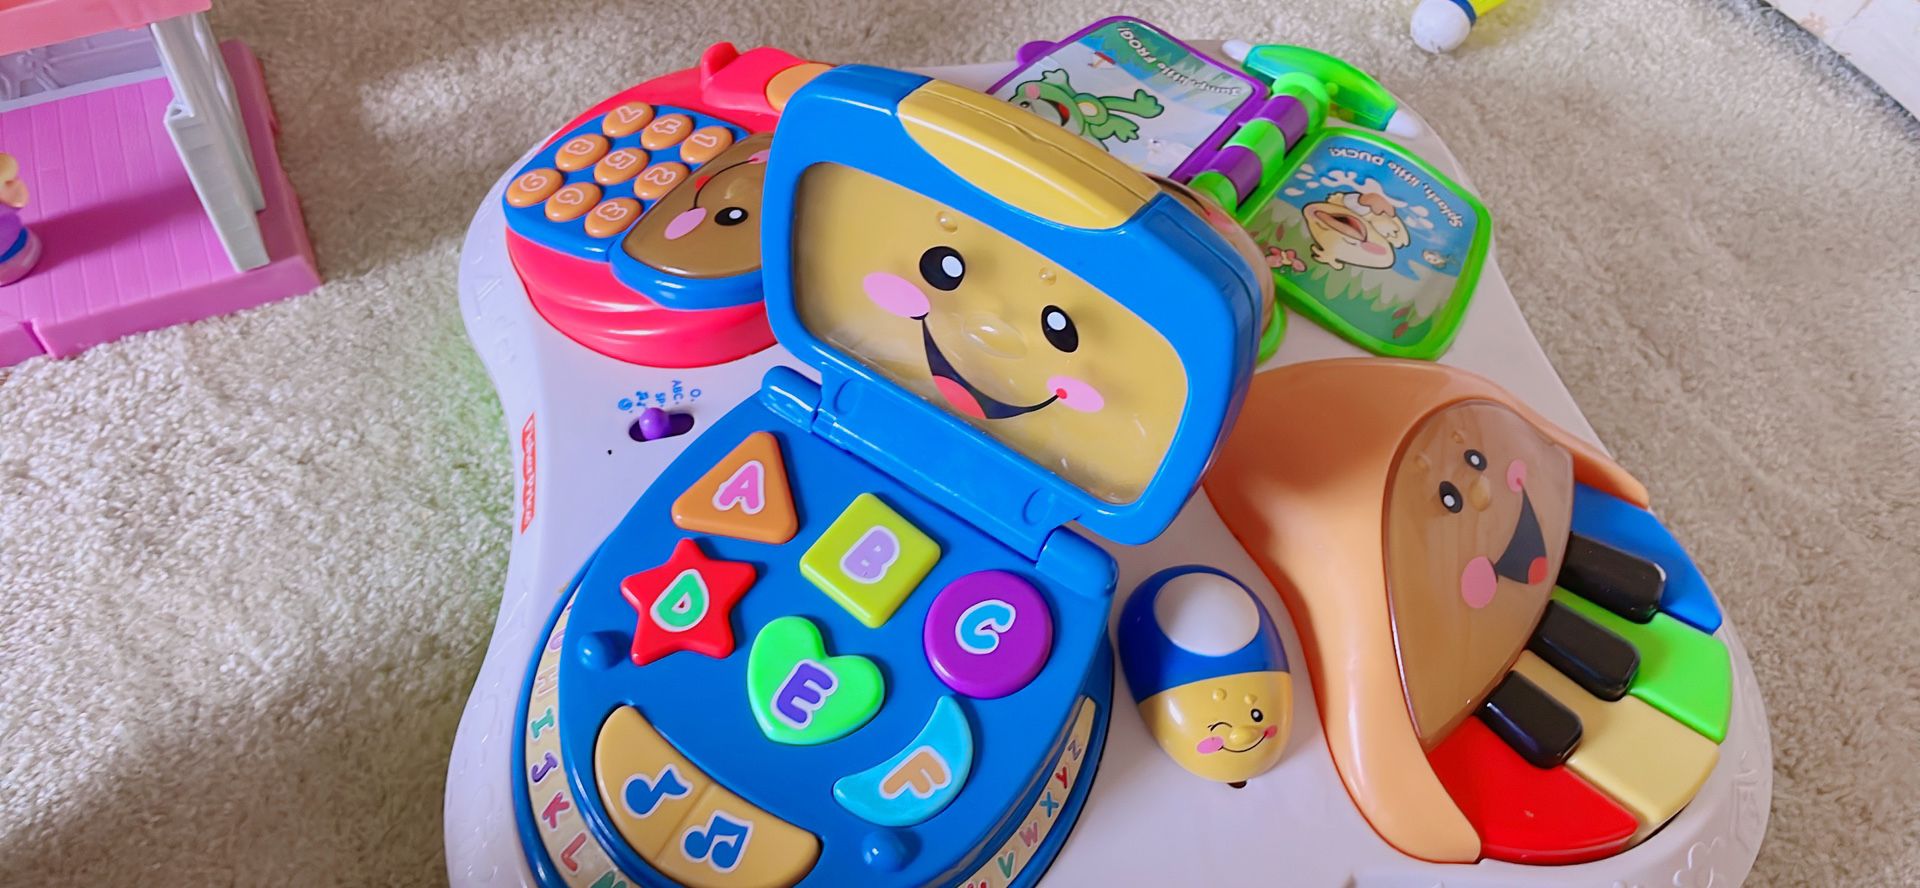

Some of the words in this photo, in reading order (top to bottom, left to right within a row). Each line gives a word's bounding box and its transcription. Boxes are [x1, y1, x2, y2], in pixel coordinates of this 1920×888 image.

[1116, 26, 1157, 63] FROG!
[1157, 62, 1189, 85] little
[617, 105, 644, 123] 7
[652, 118, 681, 135] 4
[691, 133, 718, 148] 1
[564, 139, 594, 155] 8
[604, 150, 634, 170] 5
[644, 167, 676, 186] 2
[1387, 160, 1420, 187] little
[1423, 182, 1464, 228] Splash,
[672, 379, 684, 400] ABC
[712, 459, 765, 515] A
[839, 525, 900, 584] B
[651, 568, 709, 632] D
[955, 598, 1016, 655] C
[771, 658, 839, 729] E
[530, 707, 554, 739] I
[531, 752, 558, 783] J
[879, 745, 952, 800] F
[541, 791, 570, 829] K
[997, 851, 1015, 879] V
[1018, 821, 1038, 848] W
[1039, 791, 1060, 818] X
[1055, 766, 1068, 789] Y
[1067, 739, 1082, 761] Z
[561, 832, 586, 872] L
